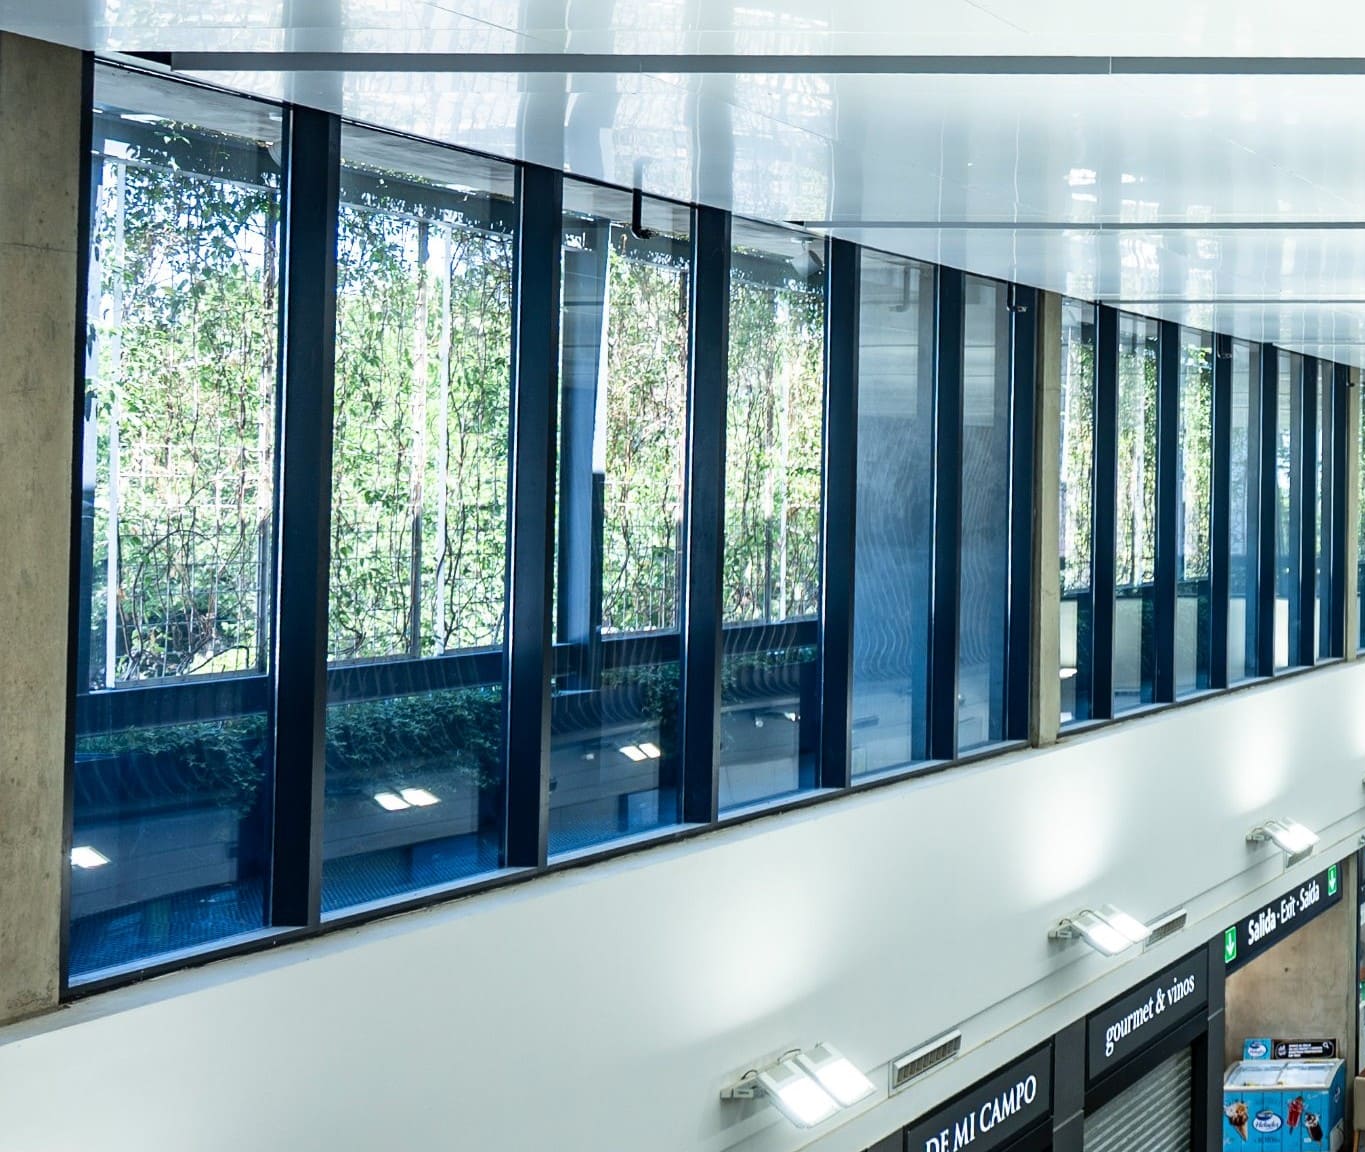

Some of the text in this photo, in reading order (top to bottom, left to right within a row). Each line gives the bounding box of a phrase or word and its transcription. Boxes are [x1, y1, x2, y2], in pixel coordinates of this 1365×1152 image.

[1248, 879, 1320, 946] Salida Exit Saída
[1105, 974, 1195, 1057] gourmet & vinos
[952, 1111, 976, 1152] MI
[979, 1075, 1038, 1133] CAMPO
